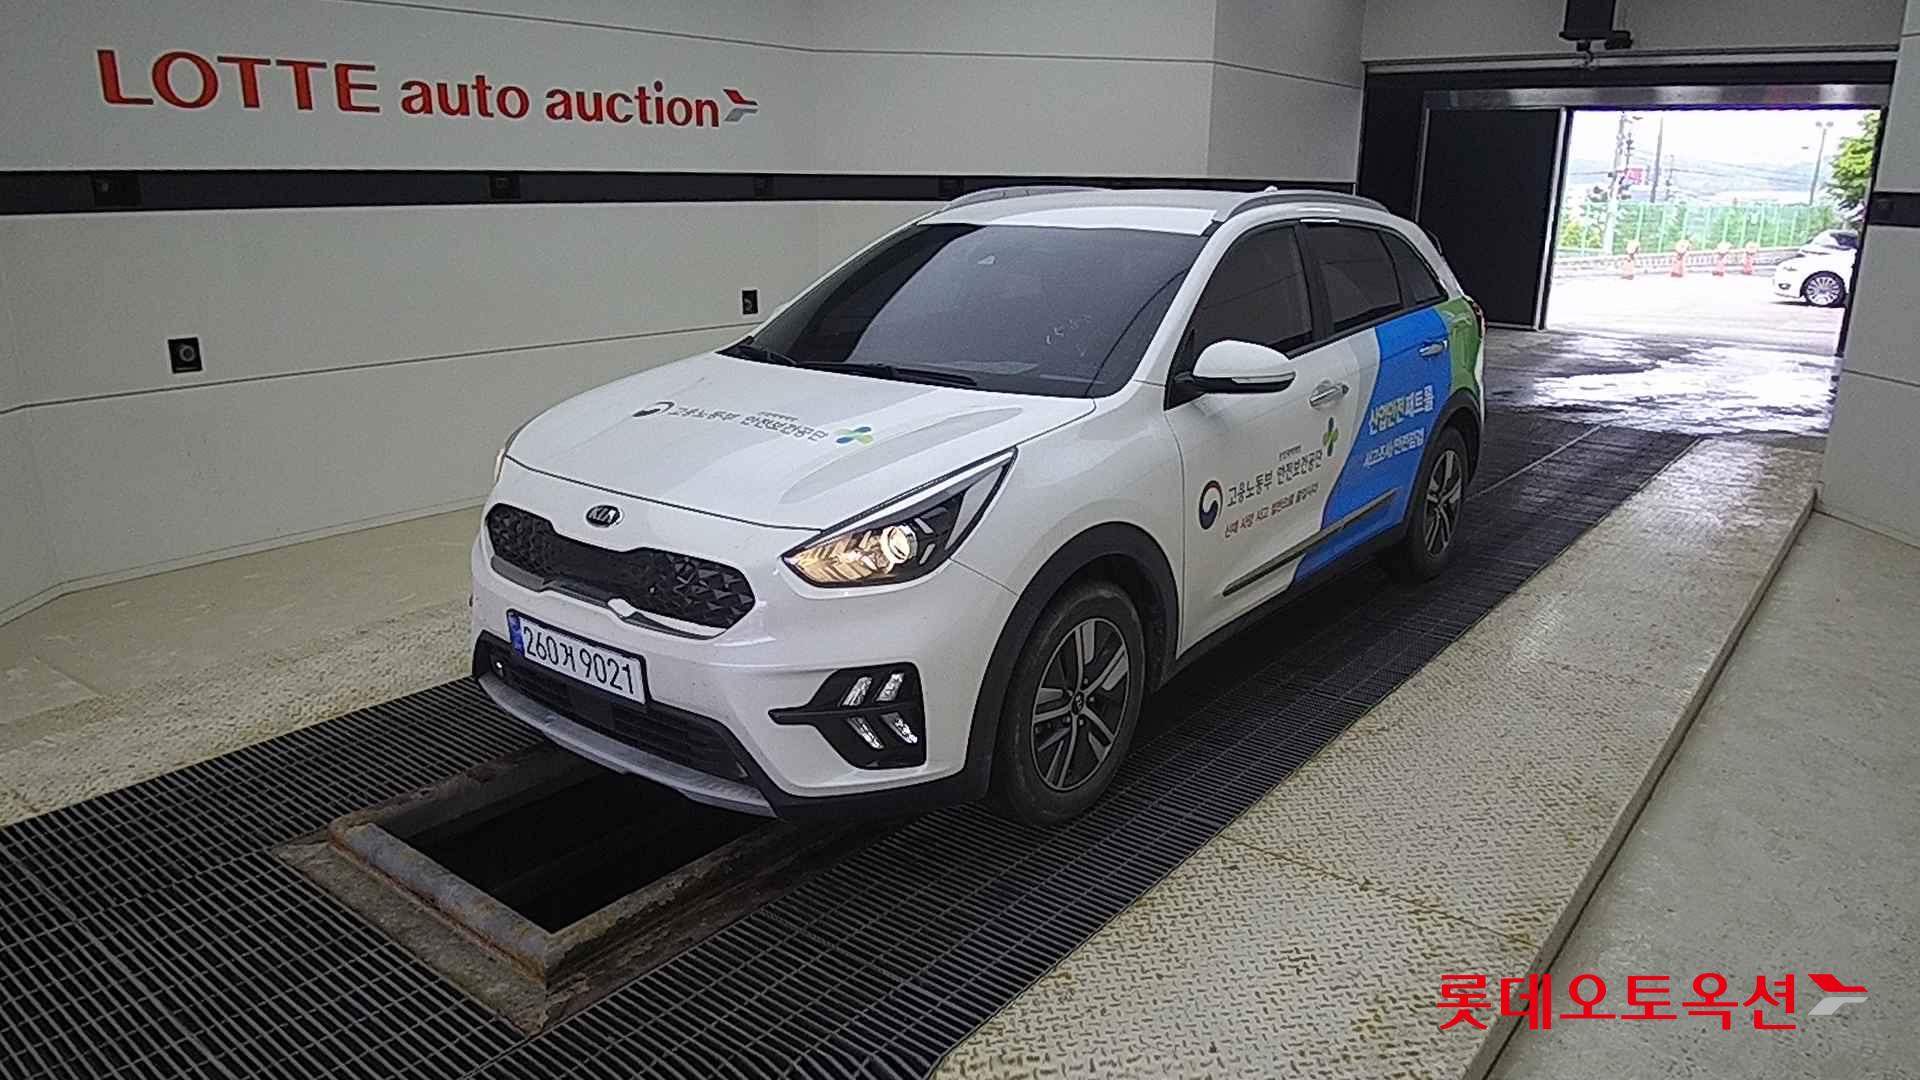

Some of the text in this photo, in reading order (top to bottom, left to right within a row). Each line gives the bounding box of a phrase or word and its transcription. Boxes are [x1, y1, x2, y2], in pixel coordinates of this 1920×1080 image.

[97, 49, 720, 128] LOTTE auto auction
[1227, 470, 1273, 508] 고용노동부
[1276, 448, 1323, 485] 안전보건공단
[588, 507, 618, 523] KIA
[580, 648, 634, 695] 9021
